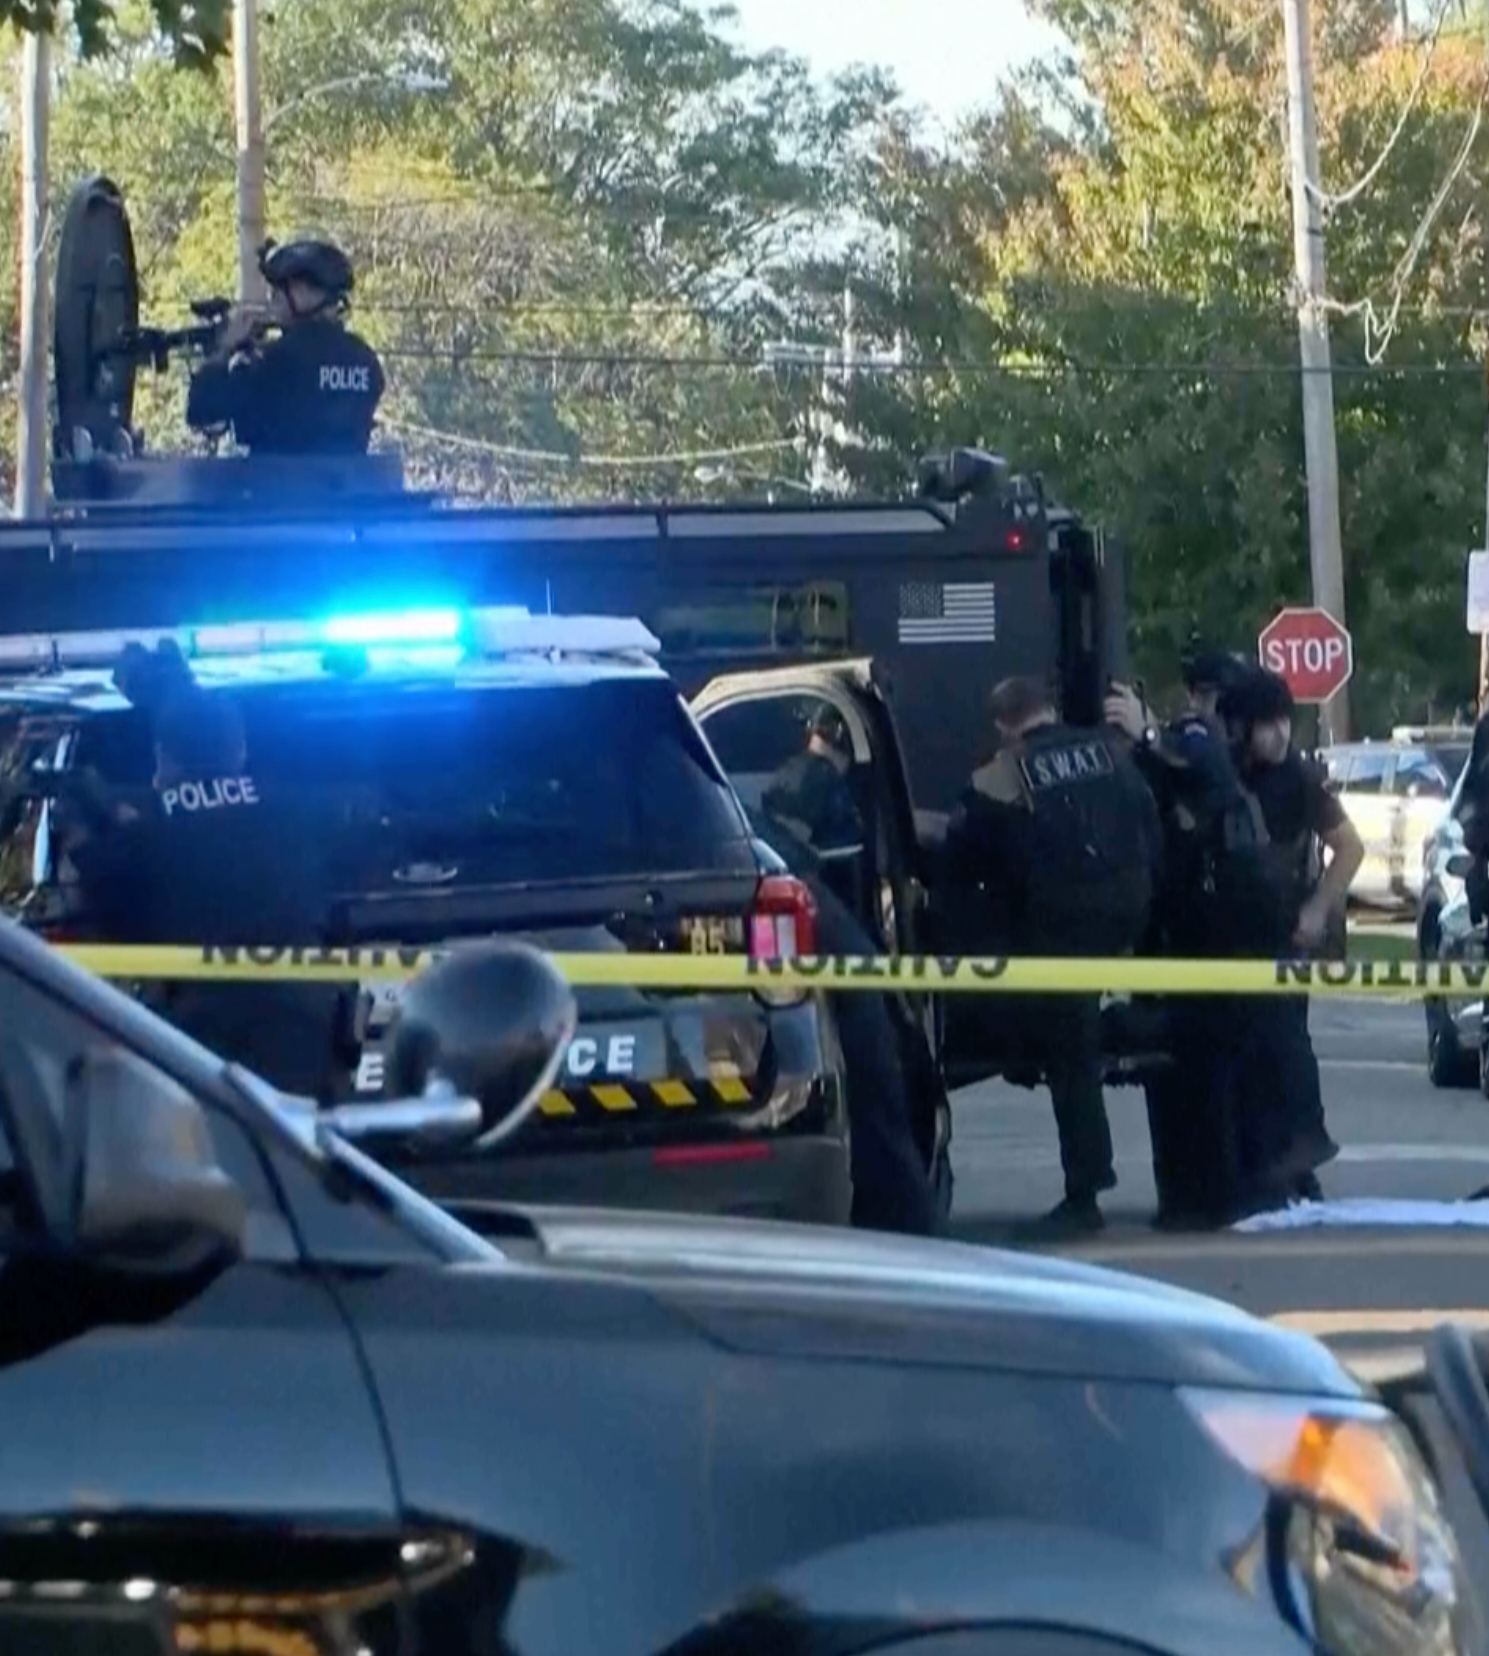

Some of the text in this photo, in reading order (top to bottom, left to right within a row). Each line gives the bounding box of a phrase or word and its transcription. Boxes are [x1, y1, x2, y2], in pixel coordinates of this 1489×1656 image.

[319, 365, 370, 392] POLICE
[1266, 637, 1344, 674] STOP
[162, 776, 260, 816] POLICE
[747, 955, 1008, 978] CAUTION
